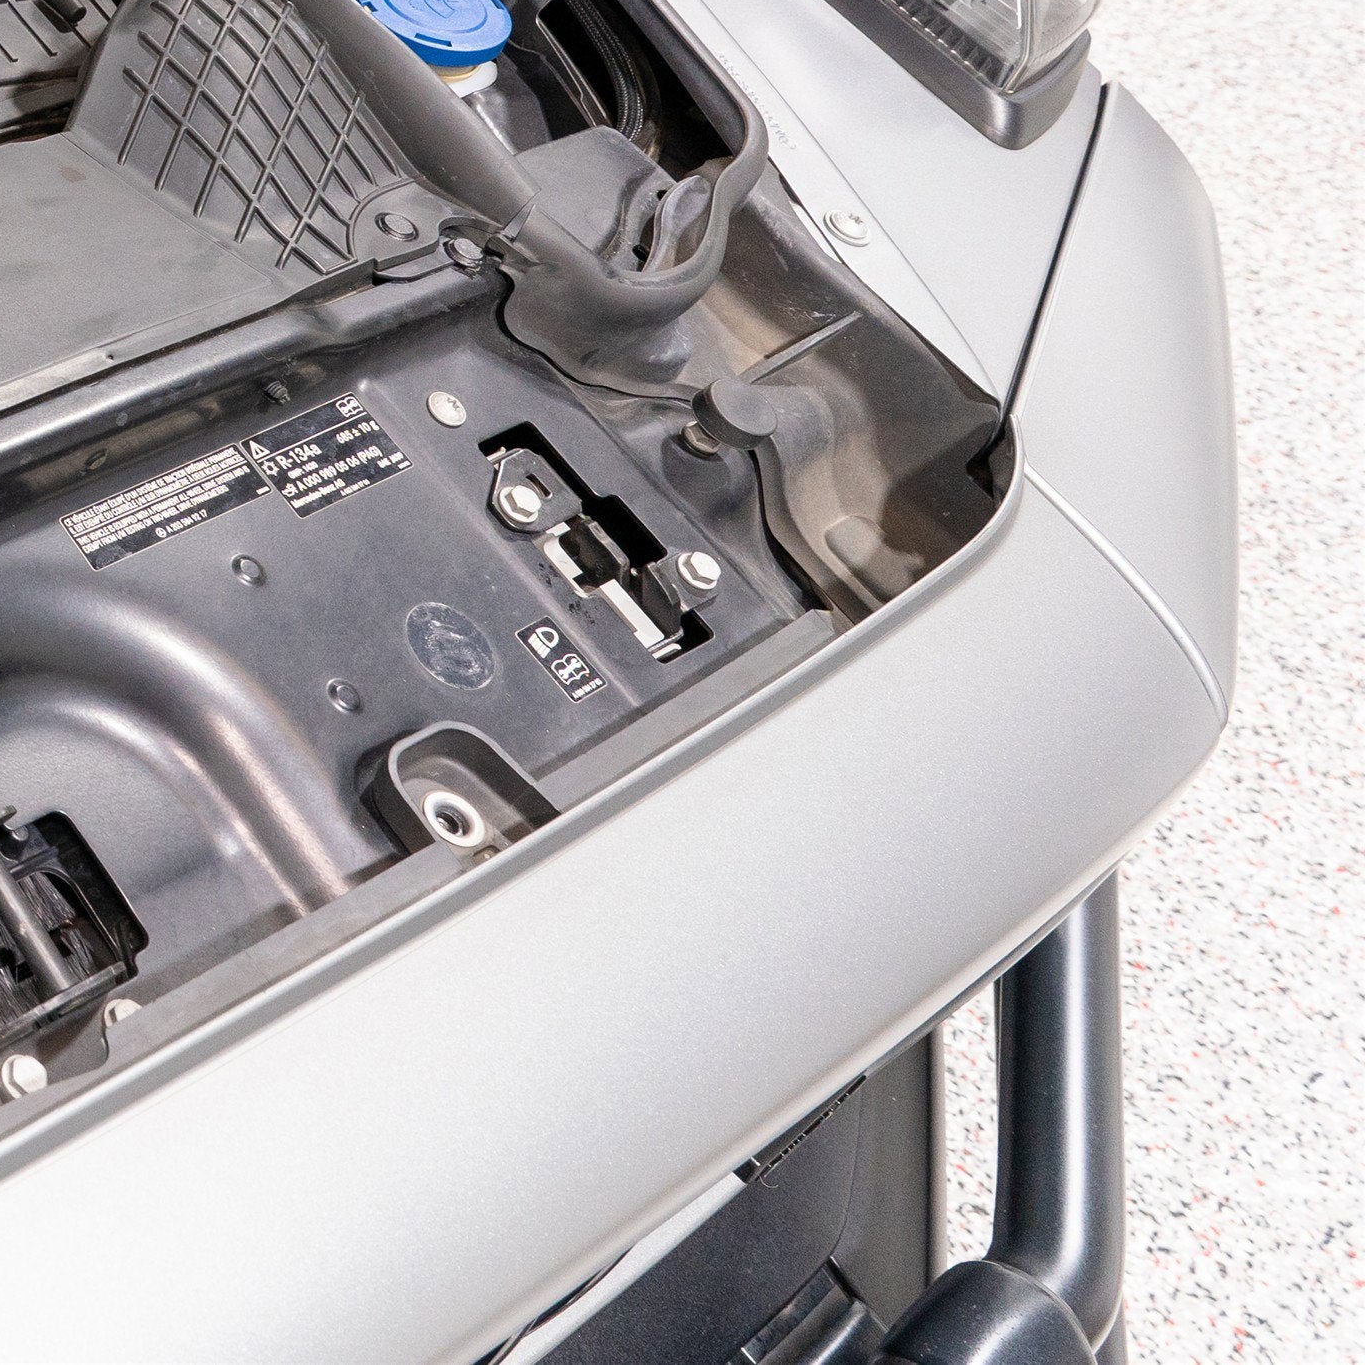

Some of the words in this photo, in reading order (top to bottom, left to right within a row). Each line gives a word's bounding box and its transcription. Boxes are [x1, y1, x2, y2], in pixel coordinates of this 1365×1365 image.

[275, 444, 322, 469] R-134a
[336, 430, 354, 444] 685
[358, 422, 371, 433] 10
[369, 420, 380, 431] g
[296, 481, 307, 491] A
[303, 473, 322, 487] 000
[319, 465, 337, 480] 989
[334, 460, 349, 473] 05
[346, 455, 360, 467] 06
[357, 445, 383, 464] (PAG)
[156, 478, 166, 487] DE
[199, 509, 207, 518] 17
[112, 515, 138, 530] EQUIPPED
[143, 517, 154, 527] ON
